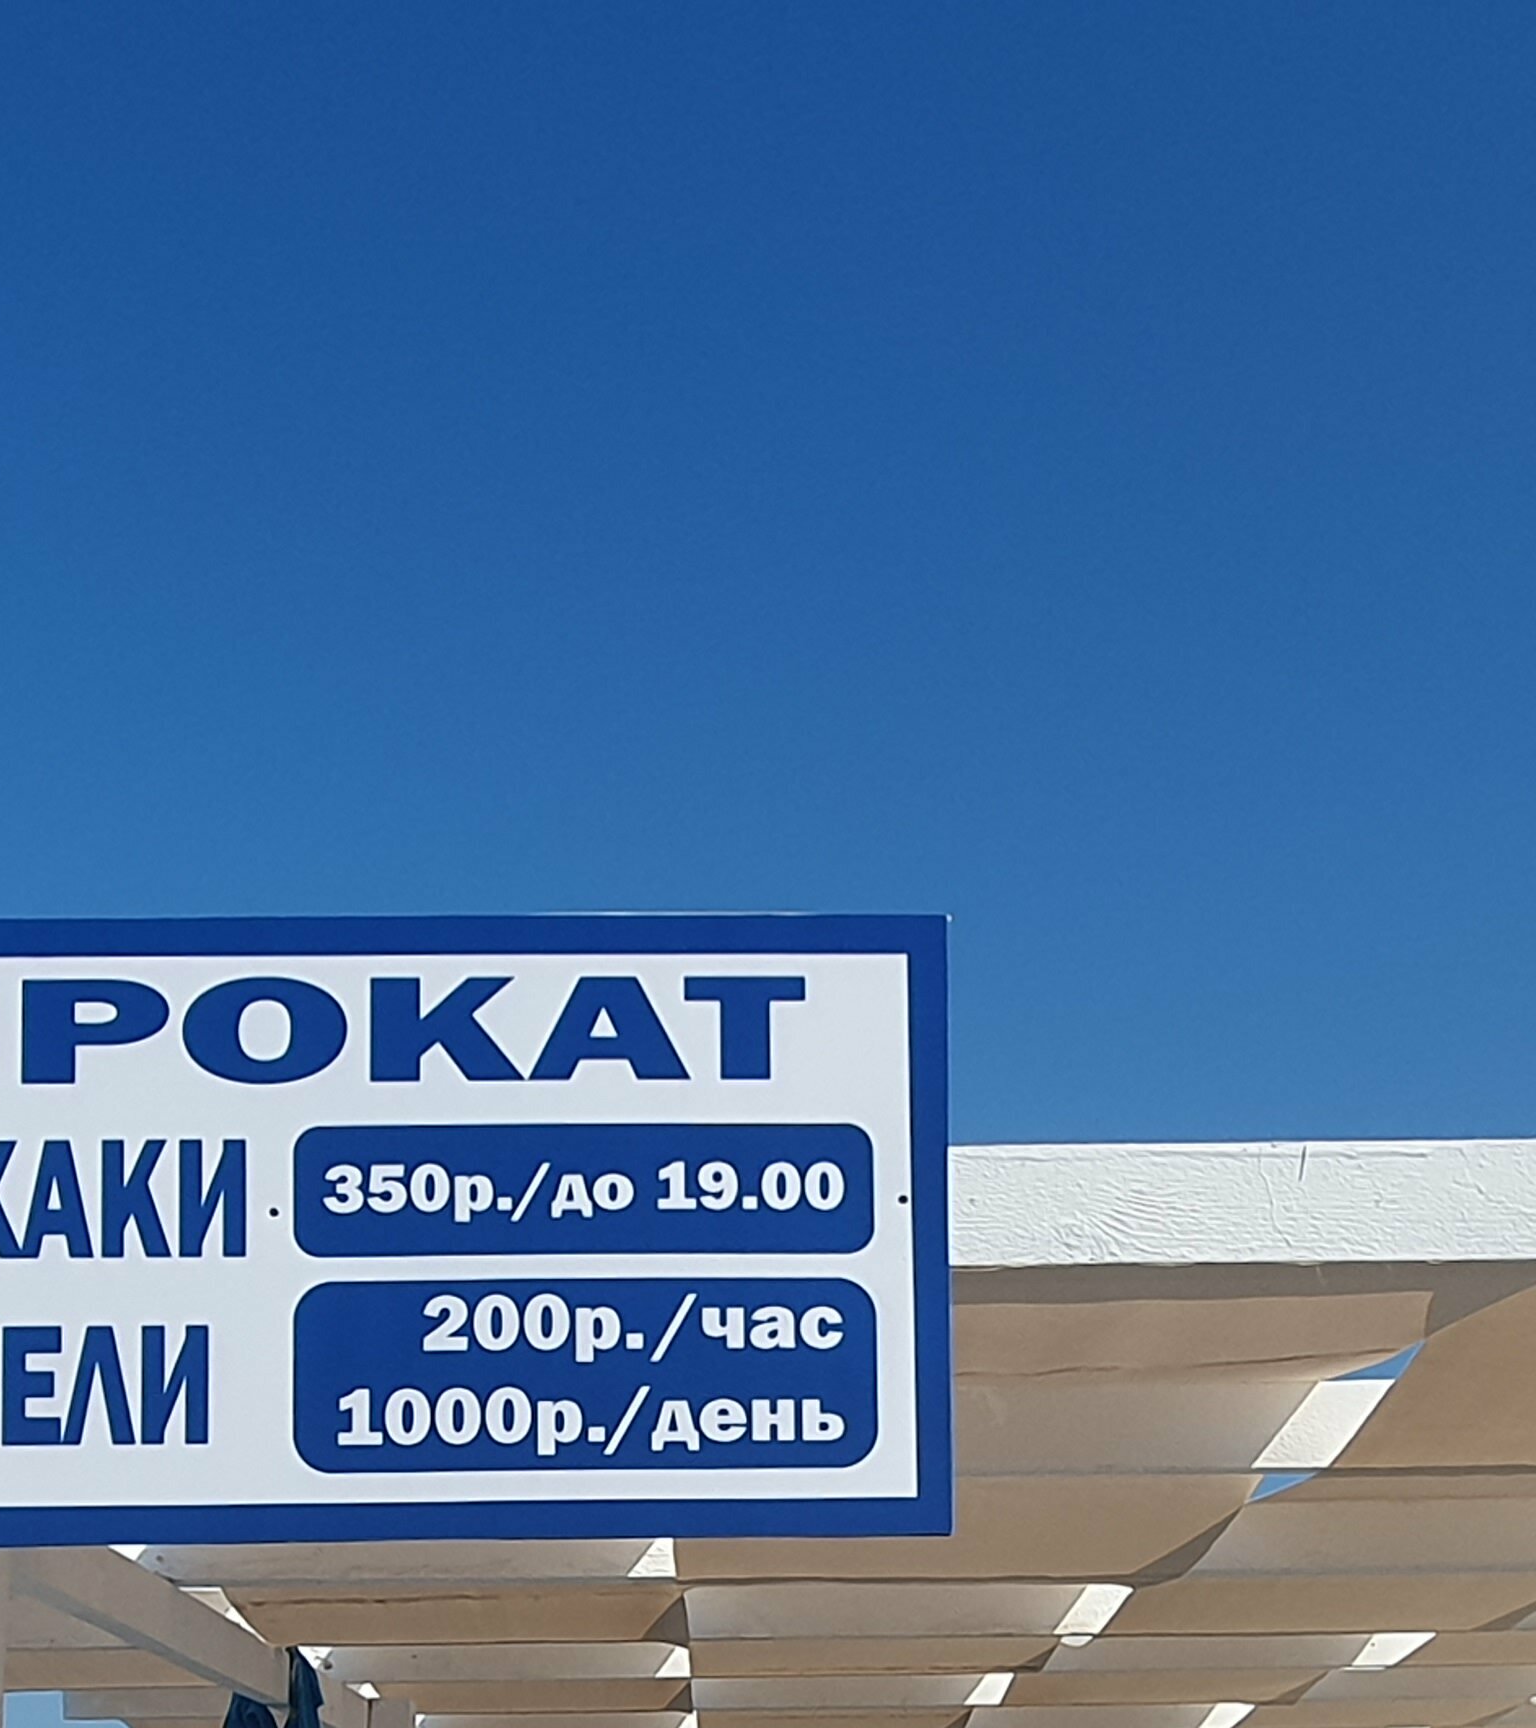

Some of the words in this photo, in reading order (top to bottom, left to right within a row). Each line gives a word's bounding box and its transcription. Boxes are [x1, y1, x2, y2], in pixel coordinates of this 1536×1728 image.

[322, 1161, 635, 1224] 350р./до
[656, 1160, 846, 1212] 19.00
[421, 1292, 844, 1364] 200р./час
[336, 1384, 846, 1457] 1000р./день
